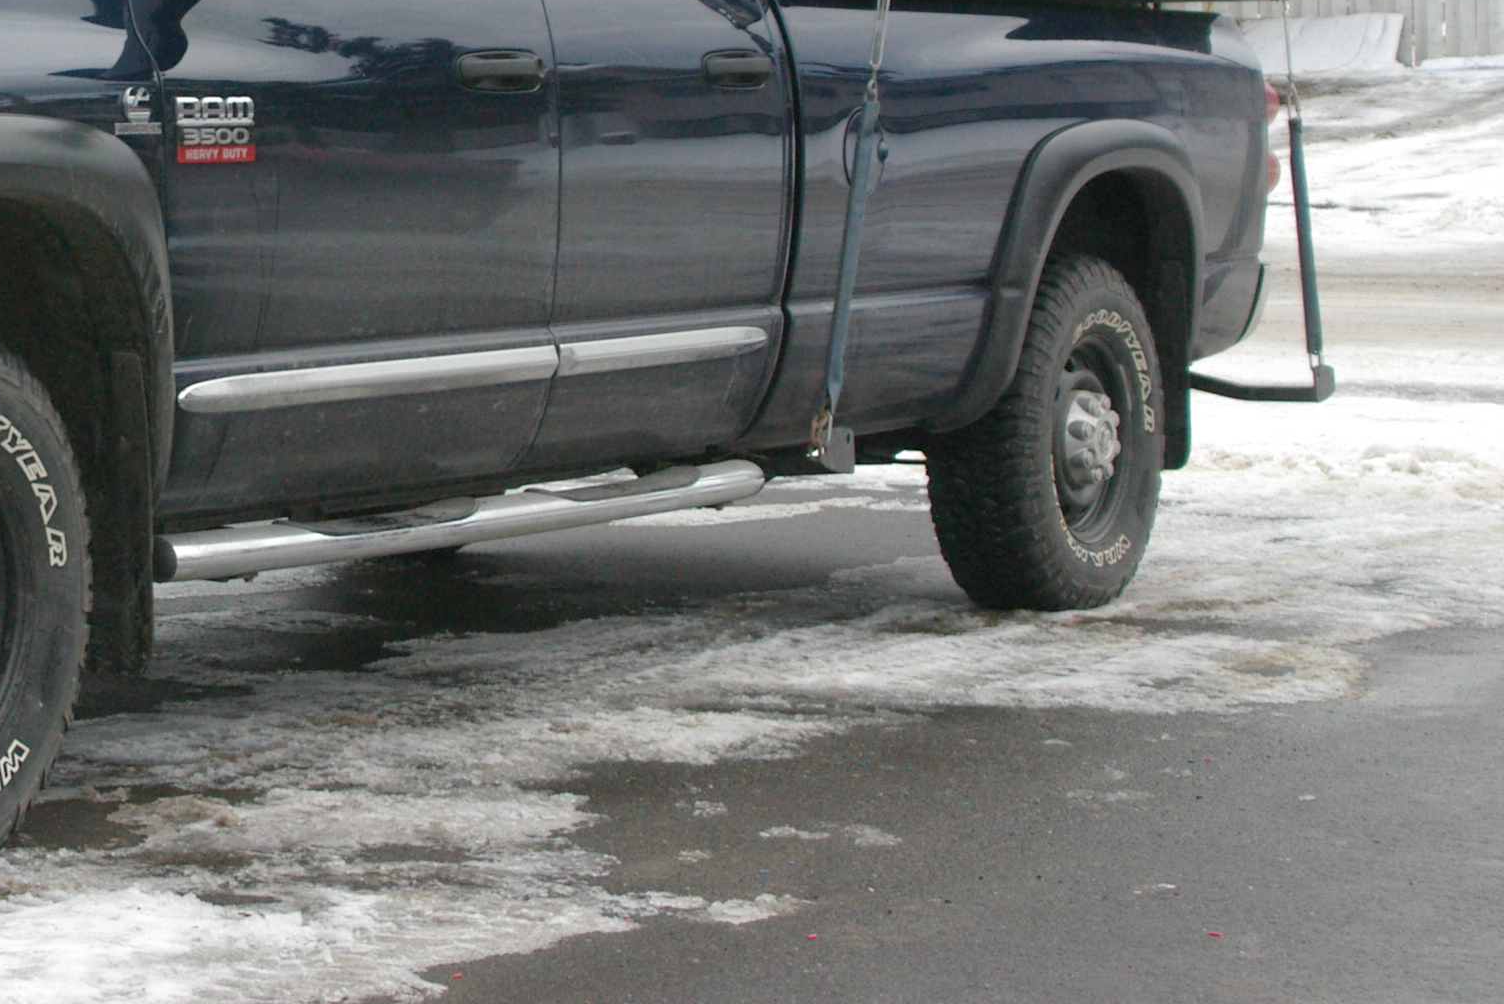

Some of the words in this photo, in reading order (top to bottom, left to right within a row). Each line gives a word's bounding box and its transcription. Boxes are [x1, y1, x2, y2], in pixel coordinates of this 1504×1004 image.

[175, 96, 254, 122] RAM
[183, 128, 249, 145] 3500
[185, 148, 218, 160] HEAVY
[222, 148, 248, 159] DUTY
[1073, 309, 1155, 434] GOODYEAR
